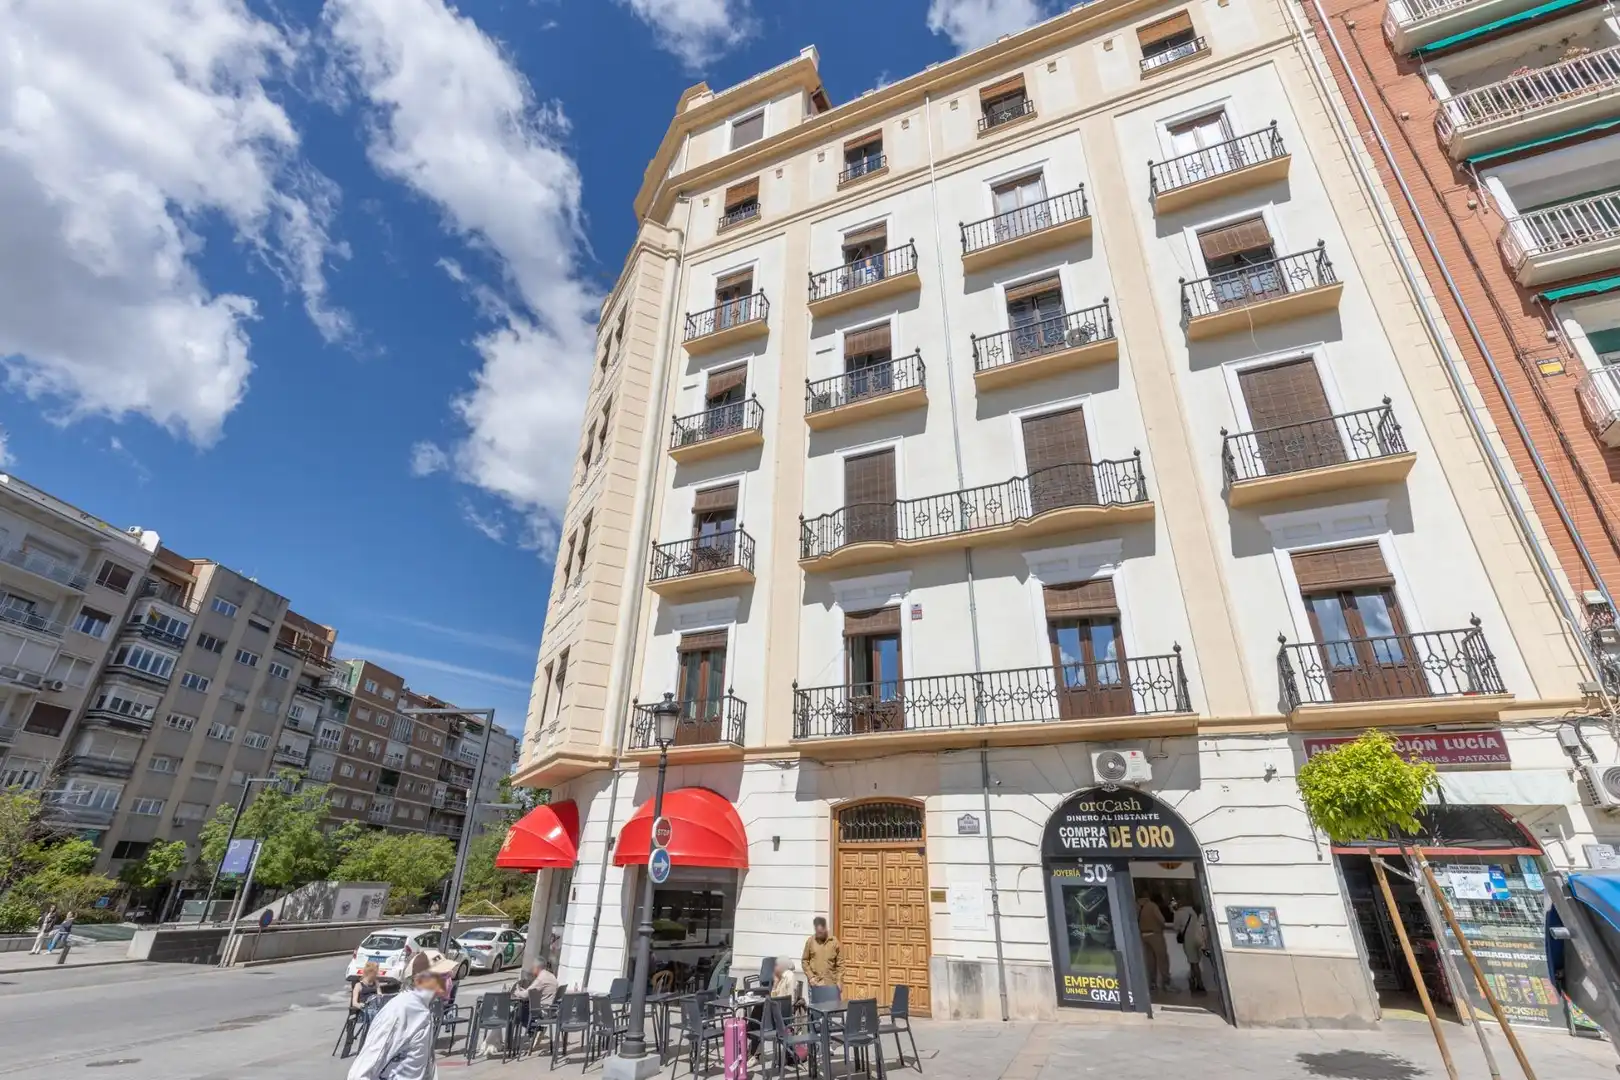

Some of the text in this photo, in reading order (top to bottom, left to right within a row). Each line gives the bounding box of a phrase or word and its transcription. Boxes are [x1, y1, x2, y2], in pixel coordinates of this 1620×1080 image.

[1443, 734, 1500, 750] LUCÍA
[1458, 754, 1507, 763] PATATAS
[1080, 797, 1142, 813] oroCash
[1114, 813, 1160, 821] INSTANTE
[1059, 826, 1107, 838] COMPRA
[1108, 825, 1175, 849] DE ORO
[1061, 837, 1108, 849] VENTA
[1053, 868, 1081, 877] JOYERÍA
[1064, 975, 1119, 989] EMPEÑOS
[1090, 989, 1134, 1005] GRATS
